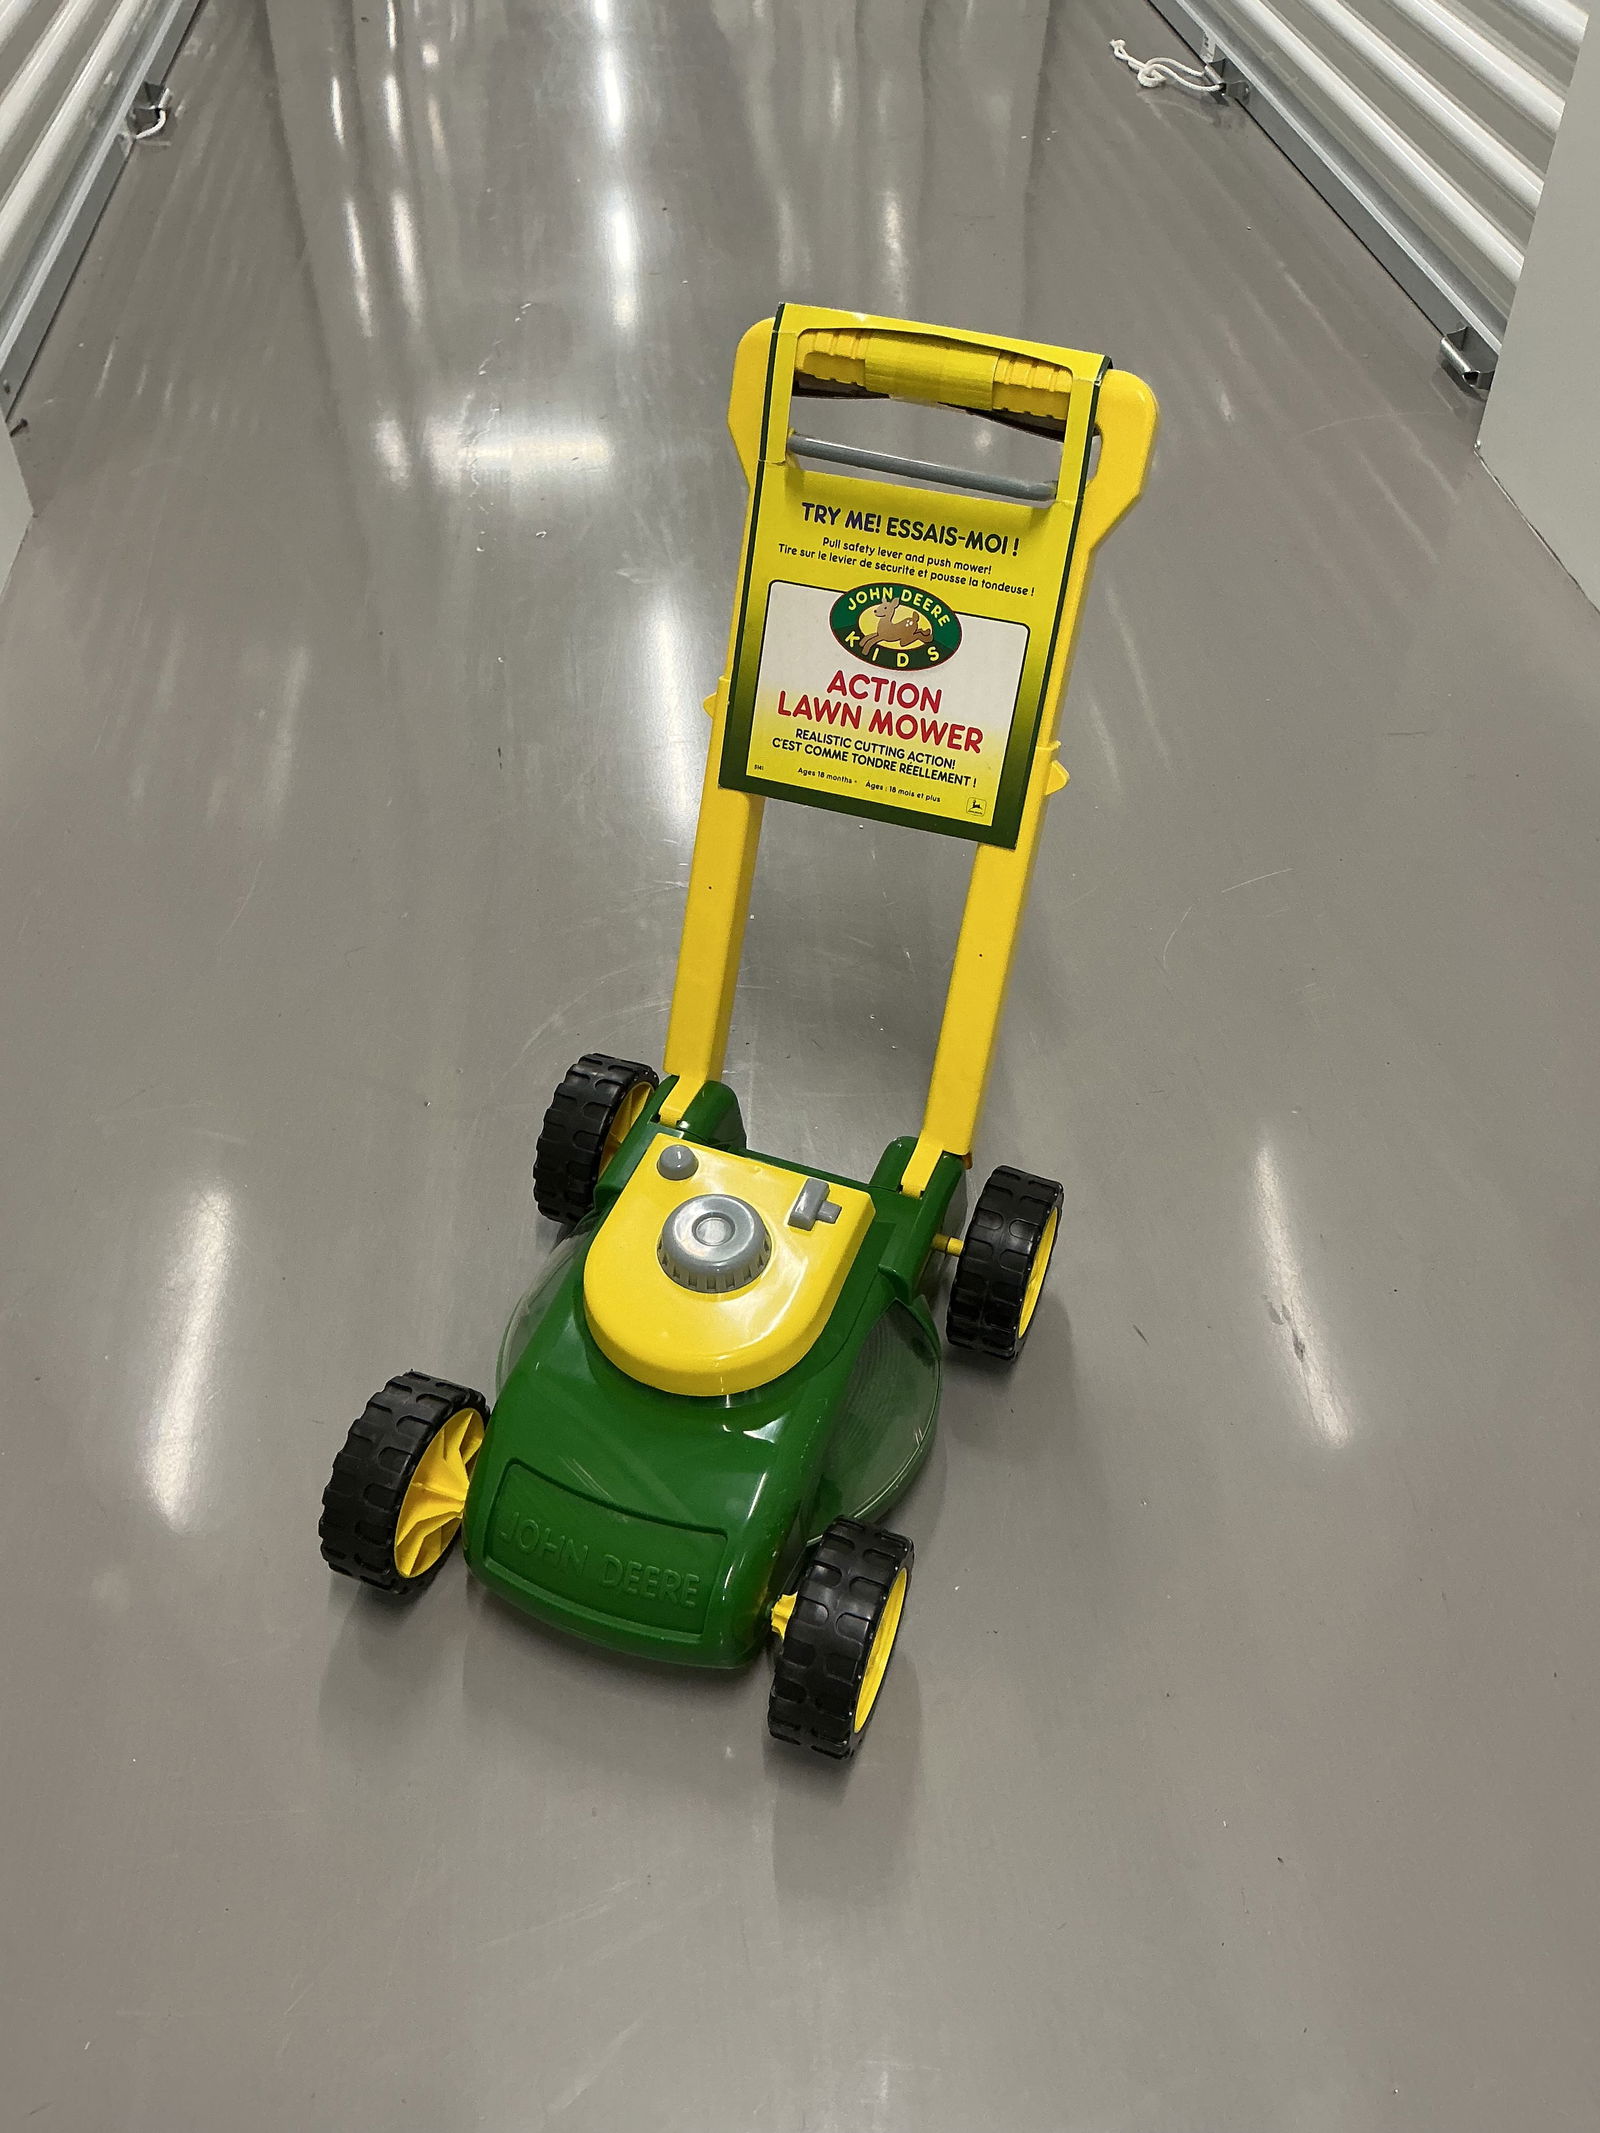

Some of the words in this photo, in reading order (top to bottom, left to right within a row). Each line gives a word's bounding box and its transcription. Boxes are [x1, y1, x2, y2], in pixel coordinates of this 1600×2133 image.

[802, 502, 841, 525] TRY
[845, 510, 881, 533] ME!
[886, 517, 1008, 554] ESSAIS-MOI
[779, 543, 797, 555] Tire
[800, 549, 815, 558] sur
[818, 551, 826, 560] le
[829, 552, 856, 565] levier
[860, 558, 872, 568] de
[918, 569, 928, 578] et
[930, 571, 966, 585] pousse
[969, 577, 978, 586] la
[981, 579, 1028, 595] tondeuse
[823, 537, 841, 549] Pull
[843, 542, 875, 556] safety
[877, 547, 902, 559] lever
[905, 553, 925, 563] and
[927, 557, 951, 568] push
[954, 561, 992, 574] mower!
[848, 587, 893, 610] JOHN
[901, 589, 950, 626] DEERE
[827, 670, 942, 714] ACTION
[778, 690, 862, 729] LAWN
[868, 709, 984, 754] MOWER
[772, 737, 802, 752] C'EST
[804, 744, 849, 762] COMME
[852, 752, 897, 772] TONDRE
[899, 761, 971, 787] RÉELLEMENT
[796, 728, 852, 749] REALISTIC
[854, 740, 905, 759] CUTTING
[907, 751, 956, 770] ACTION!
[797, 767, 816, 776] Ages
[826, 774, 853, 784] months
[889, 785, 897, 793] 18
[897, 789, 915, 797] mois
[925, 794, 941, 803] plus
[500, 1511, 590, 1576] JOHN
[601, 1553, 701, 1609] DEERE
